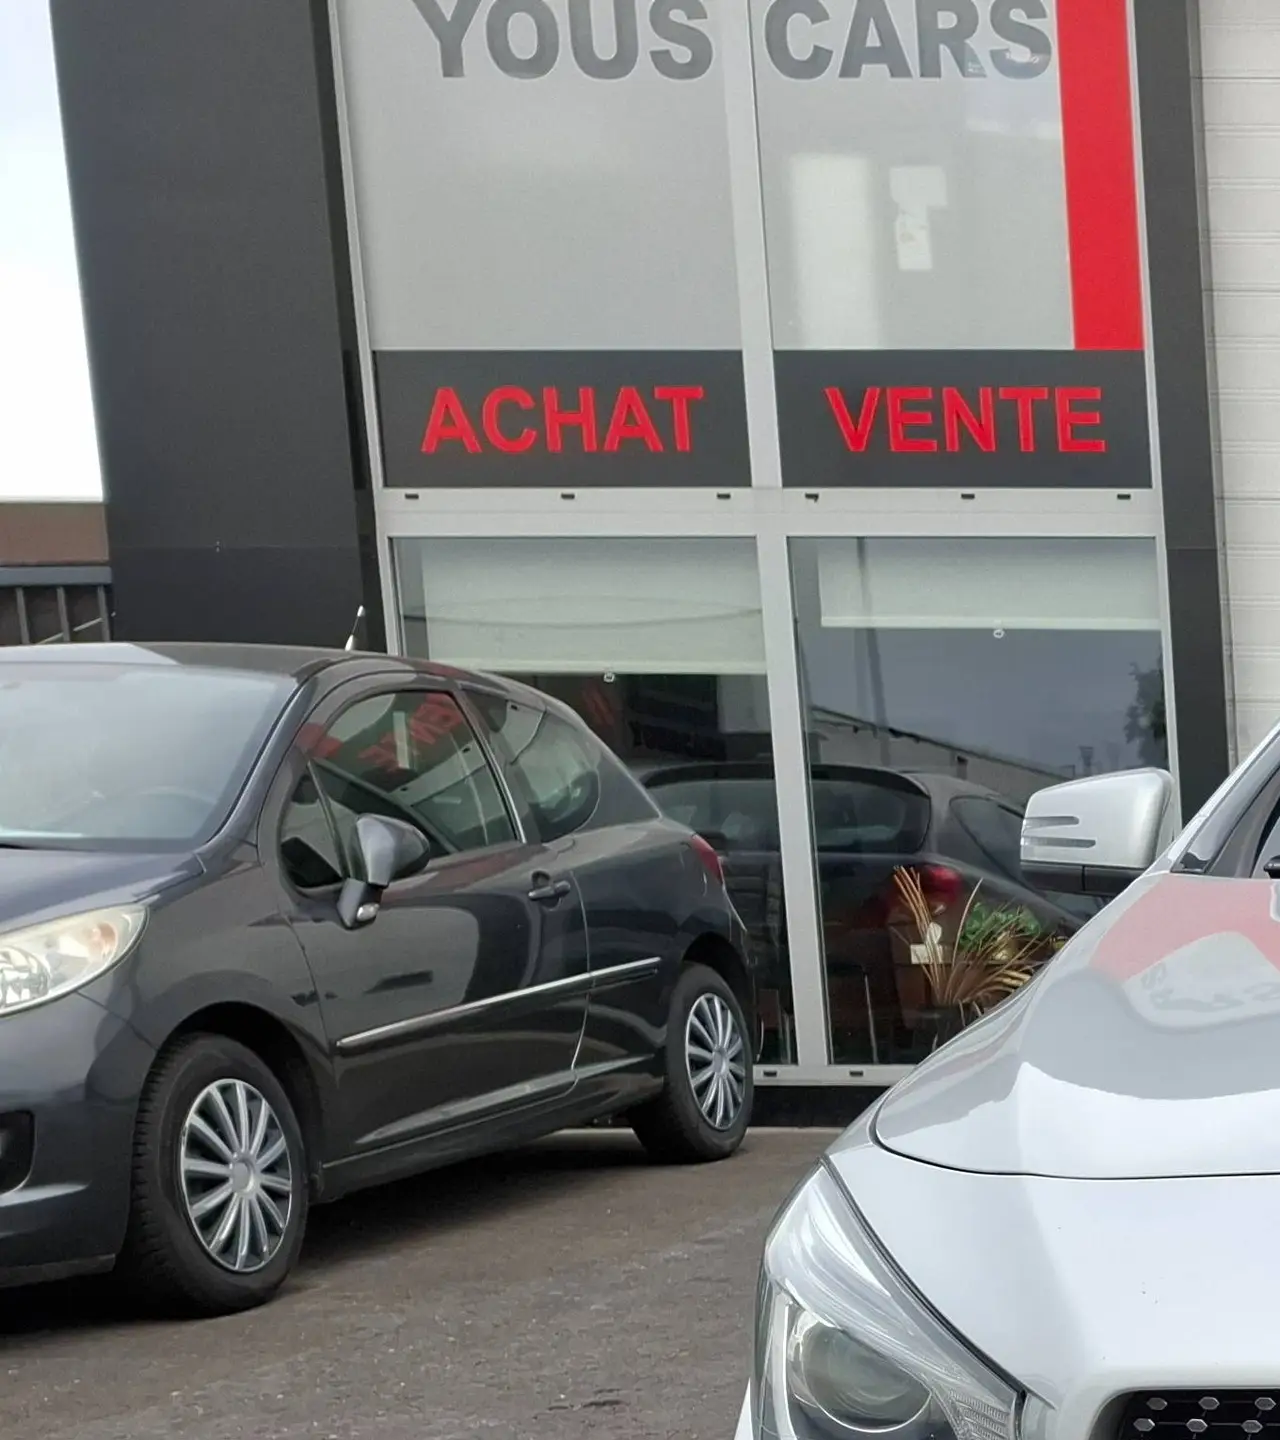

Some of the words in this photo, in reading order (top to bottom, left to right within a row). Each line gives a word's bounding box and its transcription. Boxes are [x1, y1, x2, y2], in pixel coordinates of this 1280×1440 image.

[411, 0, 714, 80] YOUS
[763, 0, 1054, 81] CARS
[420, 385, 705, 455] ACHAT
[824, 386, 1108, 454] VENTE
